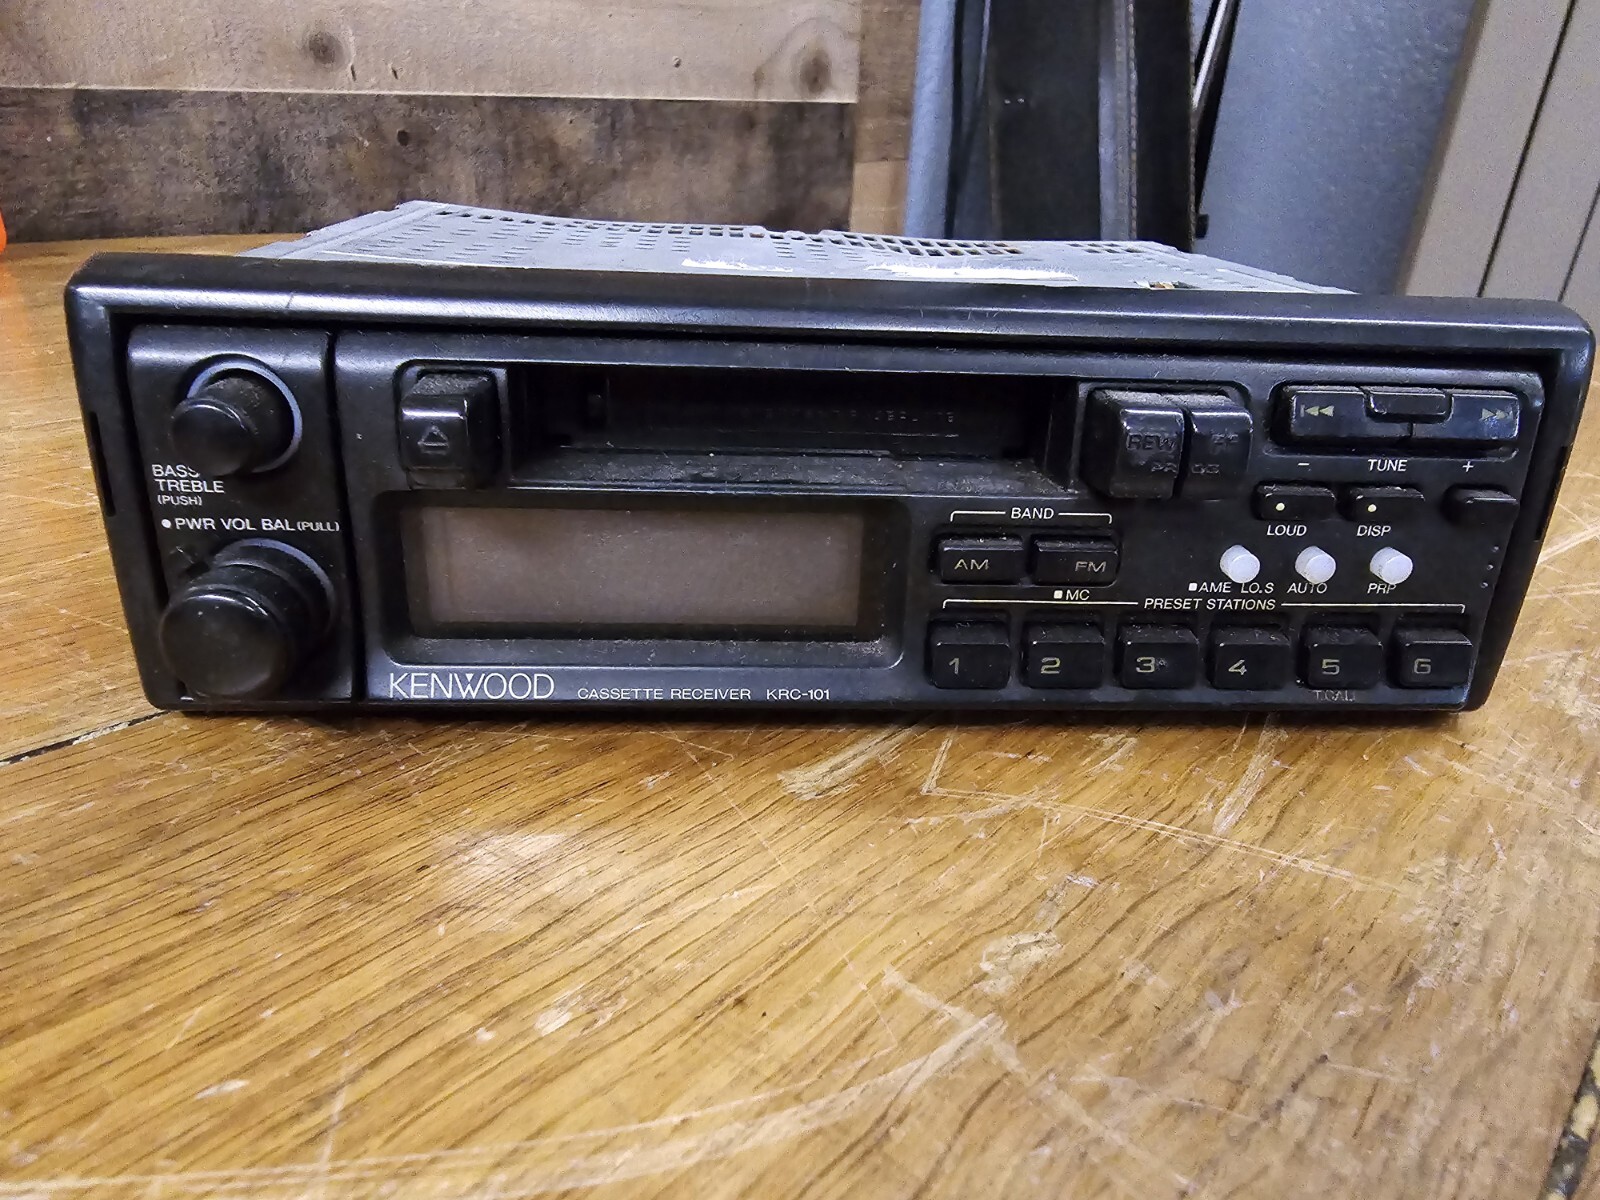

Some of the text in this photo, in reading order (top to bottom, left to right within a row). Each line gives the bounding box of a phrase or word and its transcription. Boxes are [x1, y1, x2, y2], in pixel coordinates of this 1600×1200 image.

[1126, 432, 1180, 452] REW
[151, 464, 201, 478] BASS
[1367, 458, 1408, 473] TUNE
[154, 479, 225, 494] TREBLE
[157, 494, 203, 506] (PUSH)
[1010, 507, 1055, 520] BAND
[174, 517, 217, 531] PWR
[220, 518, 257, 531] VOL
[1266, 525, 1308, 537] LOUD
[1356, 525, 1392, 538] DISP
[954, 558, 990, 571] AM
[1074, 560, 1107, 573] FM
[1065, 589, 1090, 601] MC
[1198, 582, 1232, 594] AME
[1286, 582, 1328, 595] AUTO
[1144, 598, 1276, 611] PRESET STATIONS
[948, 657, 960, 675] 1
[1040, 657, 1061, 675] 2
[1135, 656, 1156, 673] 3
[1228, 659, 1247, 676] 4
[1321, 658, 1340, 675] 5
[1413, 658, 1432, 675] 6
[388, 672, 555, 700] KENWOOD
[577, 687, 831, 701] CASSETTE RECEIVER KRC-101
